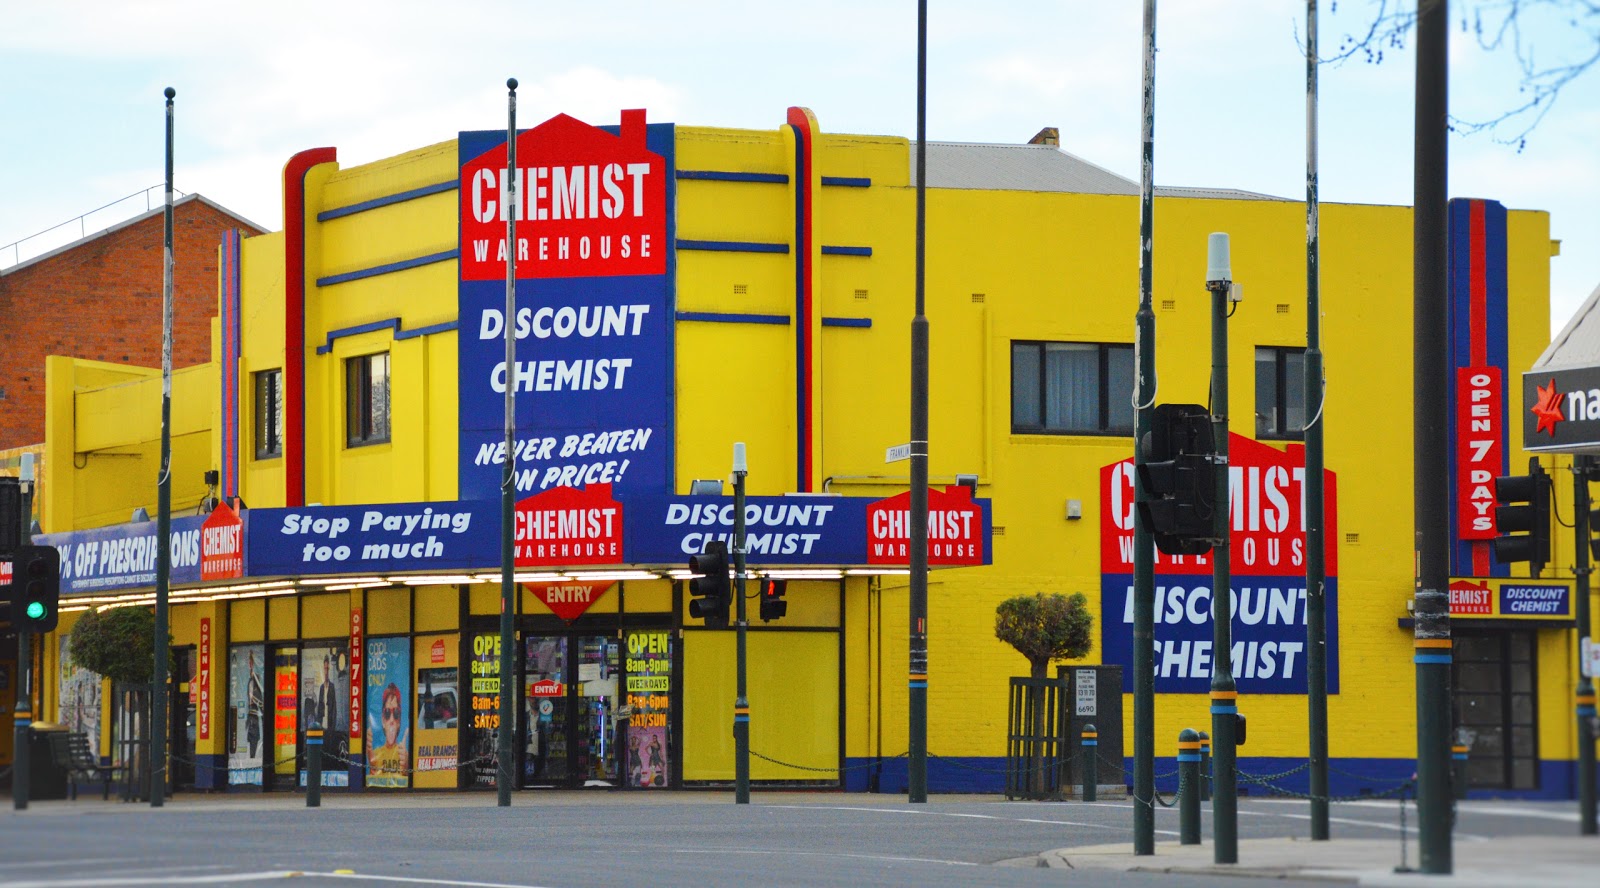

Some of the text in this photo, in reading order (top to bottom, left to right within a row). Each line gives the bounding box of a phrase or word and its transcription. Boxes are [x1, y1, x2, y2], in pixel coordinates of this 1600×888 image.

[472, 162, 650, 223] CHEMIST
[473, 234, 651, 262] WAREHOUSE
[479, 304, 650, 339] DSCOUNT
[490, 358, 632, 393] CHEMIST
[559, 427, 653, 458] BEATEN
[1469, 374, 1494, 531] OPEN 7 DAYS
[540, 459, 630, 490] PRICE!
[281, 507, 471, 539] Stop Paying
[665, 504, 833, 526] DISCOUNT
[514, 508, 616, 541] CHEMIST
[203, 525, 241, 557] CHEMIST
[302, 536, 444, 563] too much
[874, 543, 974, 557] WAROUSE
[74, 541, 99, 578] OFF
[99, 529, 200, 575] PRESCRIPONS
[203, 558, 241, 573] WAREHOUSE
[547, 585, 593, 603] ENTRY
[1506, 588, 1565, 600] DISCOUNT
[1510, 601, 1560, 612] CHEMIST
[352, 614, 360, 658] OPEN
[628, 633, 668, 653] OPEN
[473, 636, 501, 656] OPE
[352, 664, 359, 680] 7
[471, 661, 500, 675] 8am-9
[626, 658, 669, 674] 8am-9pm
[201, 670, 208, 685] 7
[474, 680, 500, 690] WEEKD
[628, 679, 667, 689] WEEKDAYS
[534, 685, 559, 694] ENTRY
[472, 697, 500, 710] 8am-6
[627, 694, 669, 711] 8am-6pm
[474, 715, 500, 730] SAT/S
[629, 713, 667, 728] SAT/SUN
[418, 746, 431, 757] REAL
